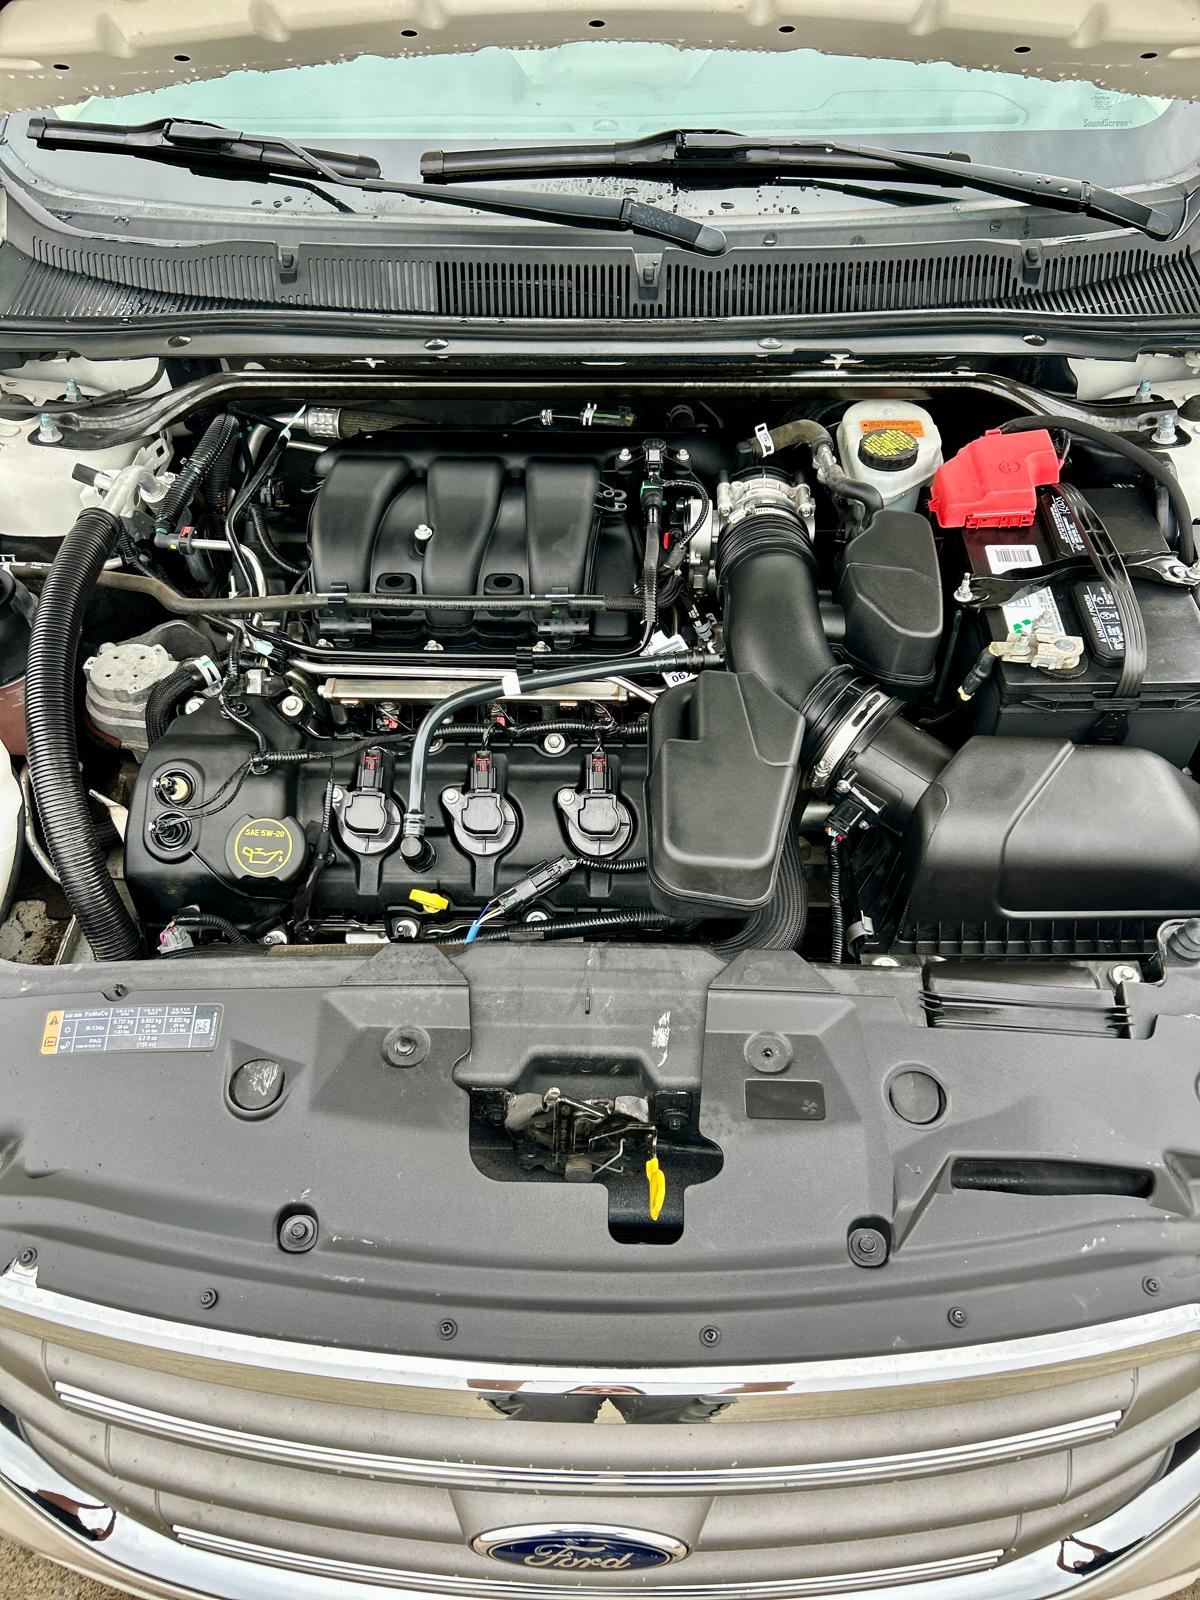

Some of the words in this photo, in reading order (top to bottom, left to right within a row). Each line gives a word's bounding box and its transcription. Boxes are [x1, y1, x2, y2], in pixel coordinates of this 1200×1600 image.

[1092, 616, 1106, 638] DANGER
[245, 828, 260, 837] SAE
[260, 829, 285, 838] 5W-20
[523, 1544, 635, 1569] Ford
